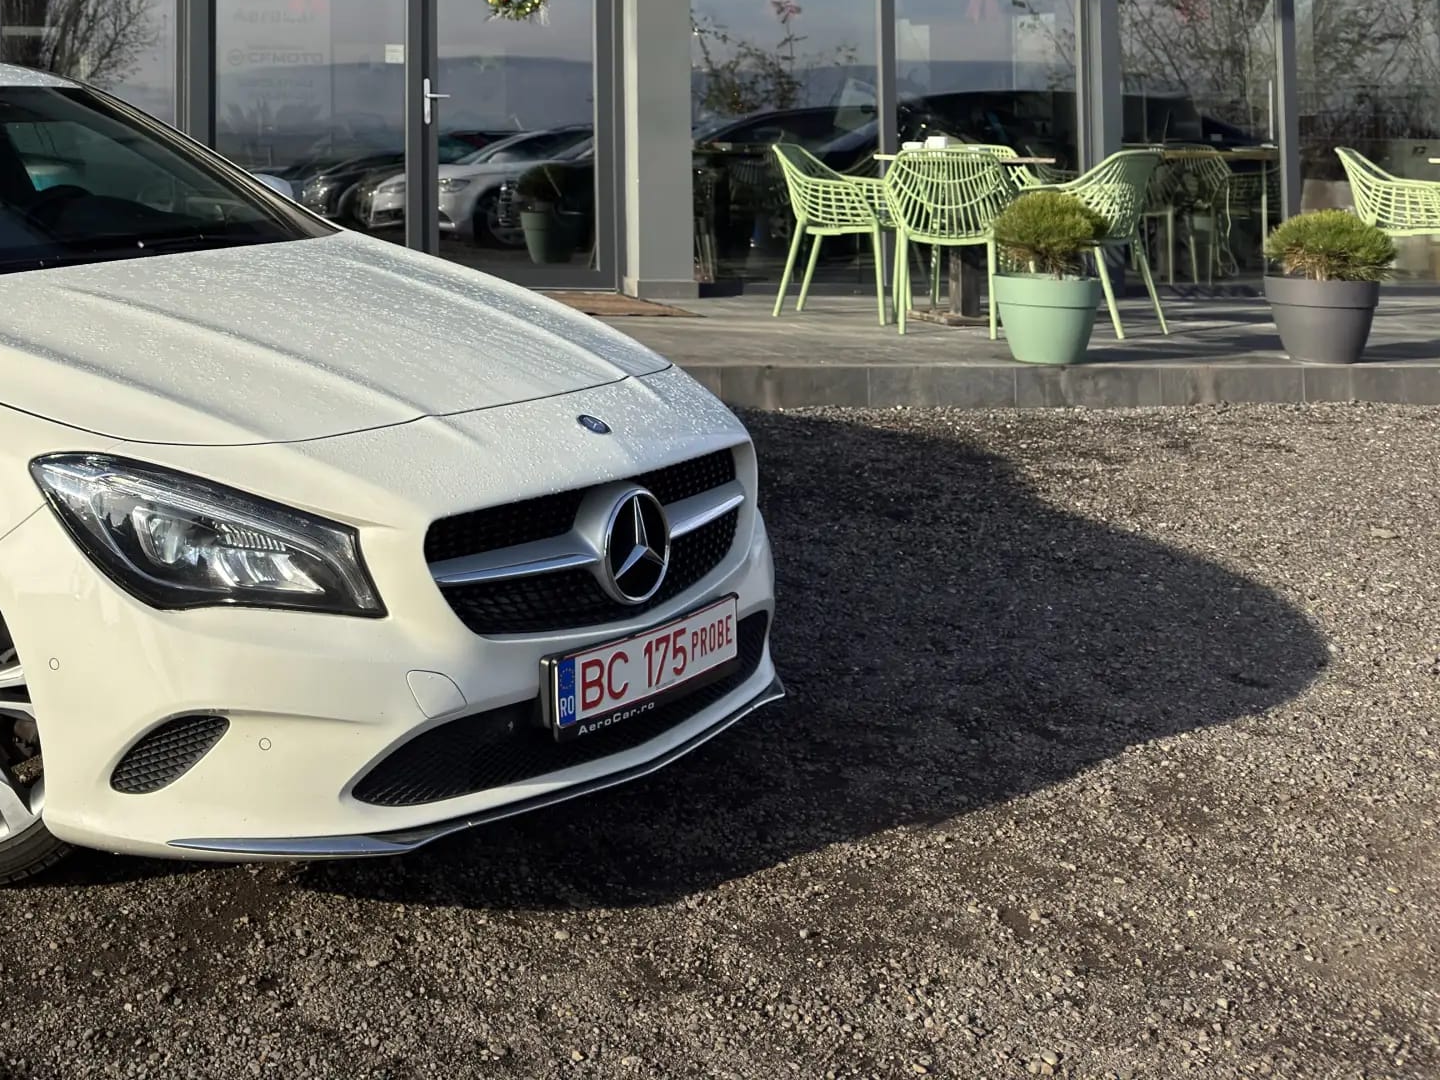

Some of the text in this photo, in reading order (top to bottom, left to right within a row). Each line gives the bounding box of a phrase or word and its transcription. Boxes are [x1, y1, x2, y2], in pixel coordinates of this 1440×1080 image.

[581, 614, 733, 712] BC 175 PROBE
[560, 695, 575, 718] RO
[578, 701, 656, 736] AeroCar.ro
